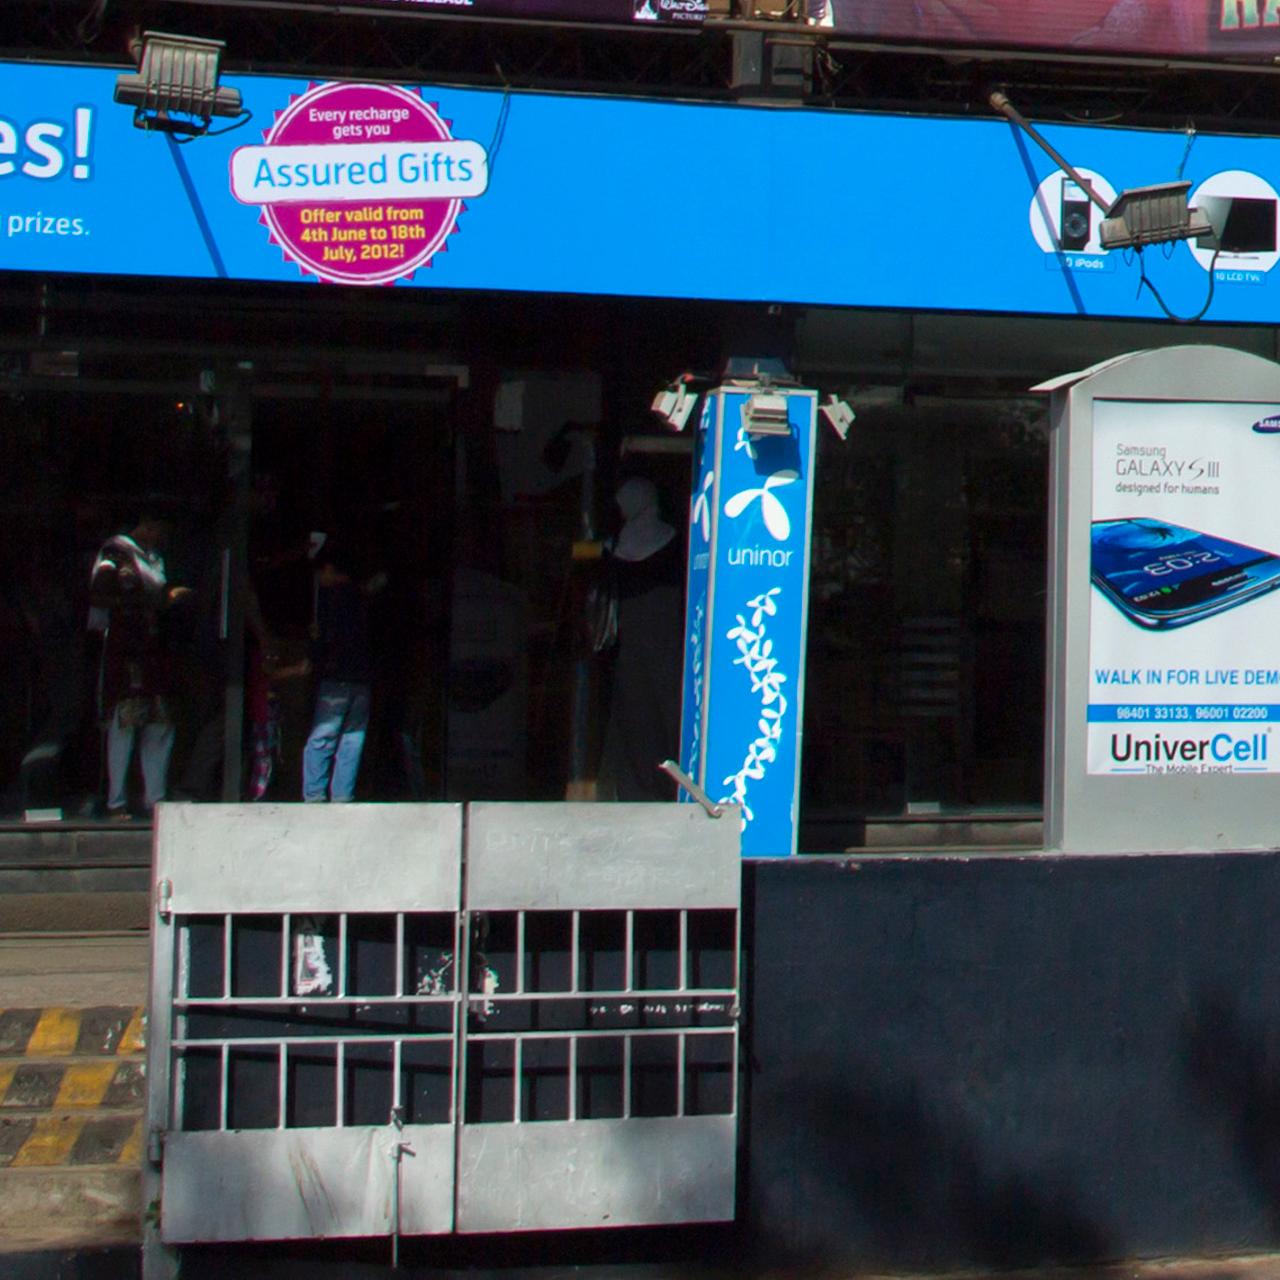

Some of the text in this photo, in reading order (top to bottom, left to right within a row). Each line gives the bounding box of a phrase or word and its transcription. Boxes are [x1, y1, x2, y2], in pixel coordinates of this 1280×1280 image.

[307, 105, 410, 125] Every recharge
[332, 122, 391, 141] gets you
[253, 152, 474, 190] Assured Gifts
[7, 211, 91, 237] prizes.
[300, 204, 425, 225] Offer valid from
[301, 223, 427, 244] 4th June to 18th
[322, 242, 405, 265] July, 2012!
[1116, 442, 1167, 461] Samsung
[1115, 459, 1185, 477] GALAXY
[1115, 481, 1220, 497] designed for humans
[727, 543, 794, 568] uninor
[1095, 669, 1142, 686] WALK
[1146, 669, 1163, 686] IN
[1166, 669, 1200, 686] FOR
[1205, 669, 1240, 686] LIVE
[1109, 731, 1269, 763] UniverCell
[1146, 763, 1164, 774] The
[1165, 763, 1199, 775] Mobile
